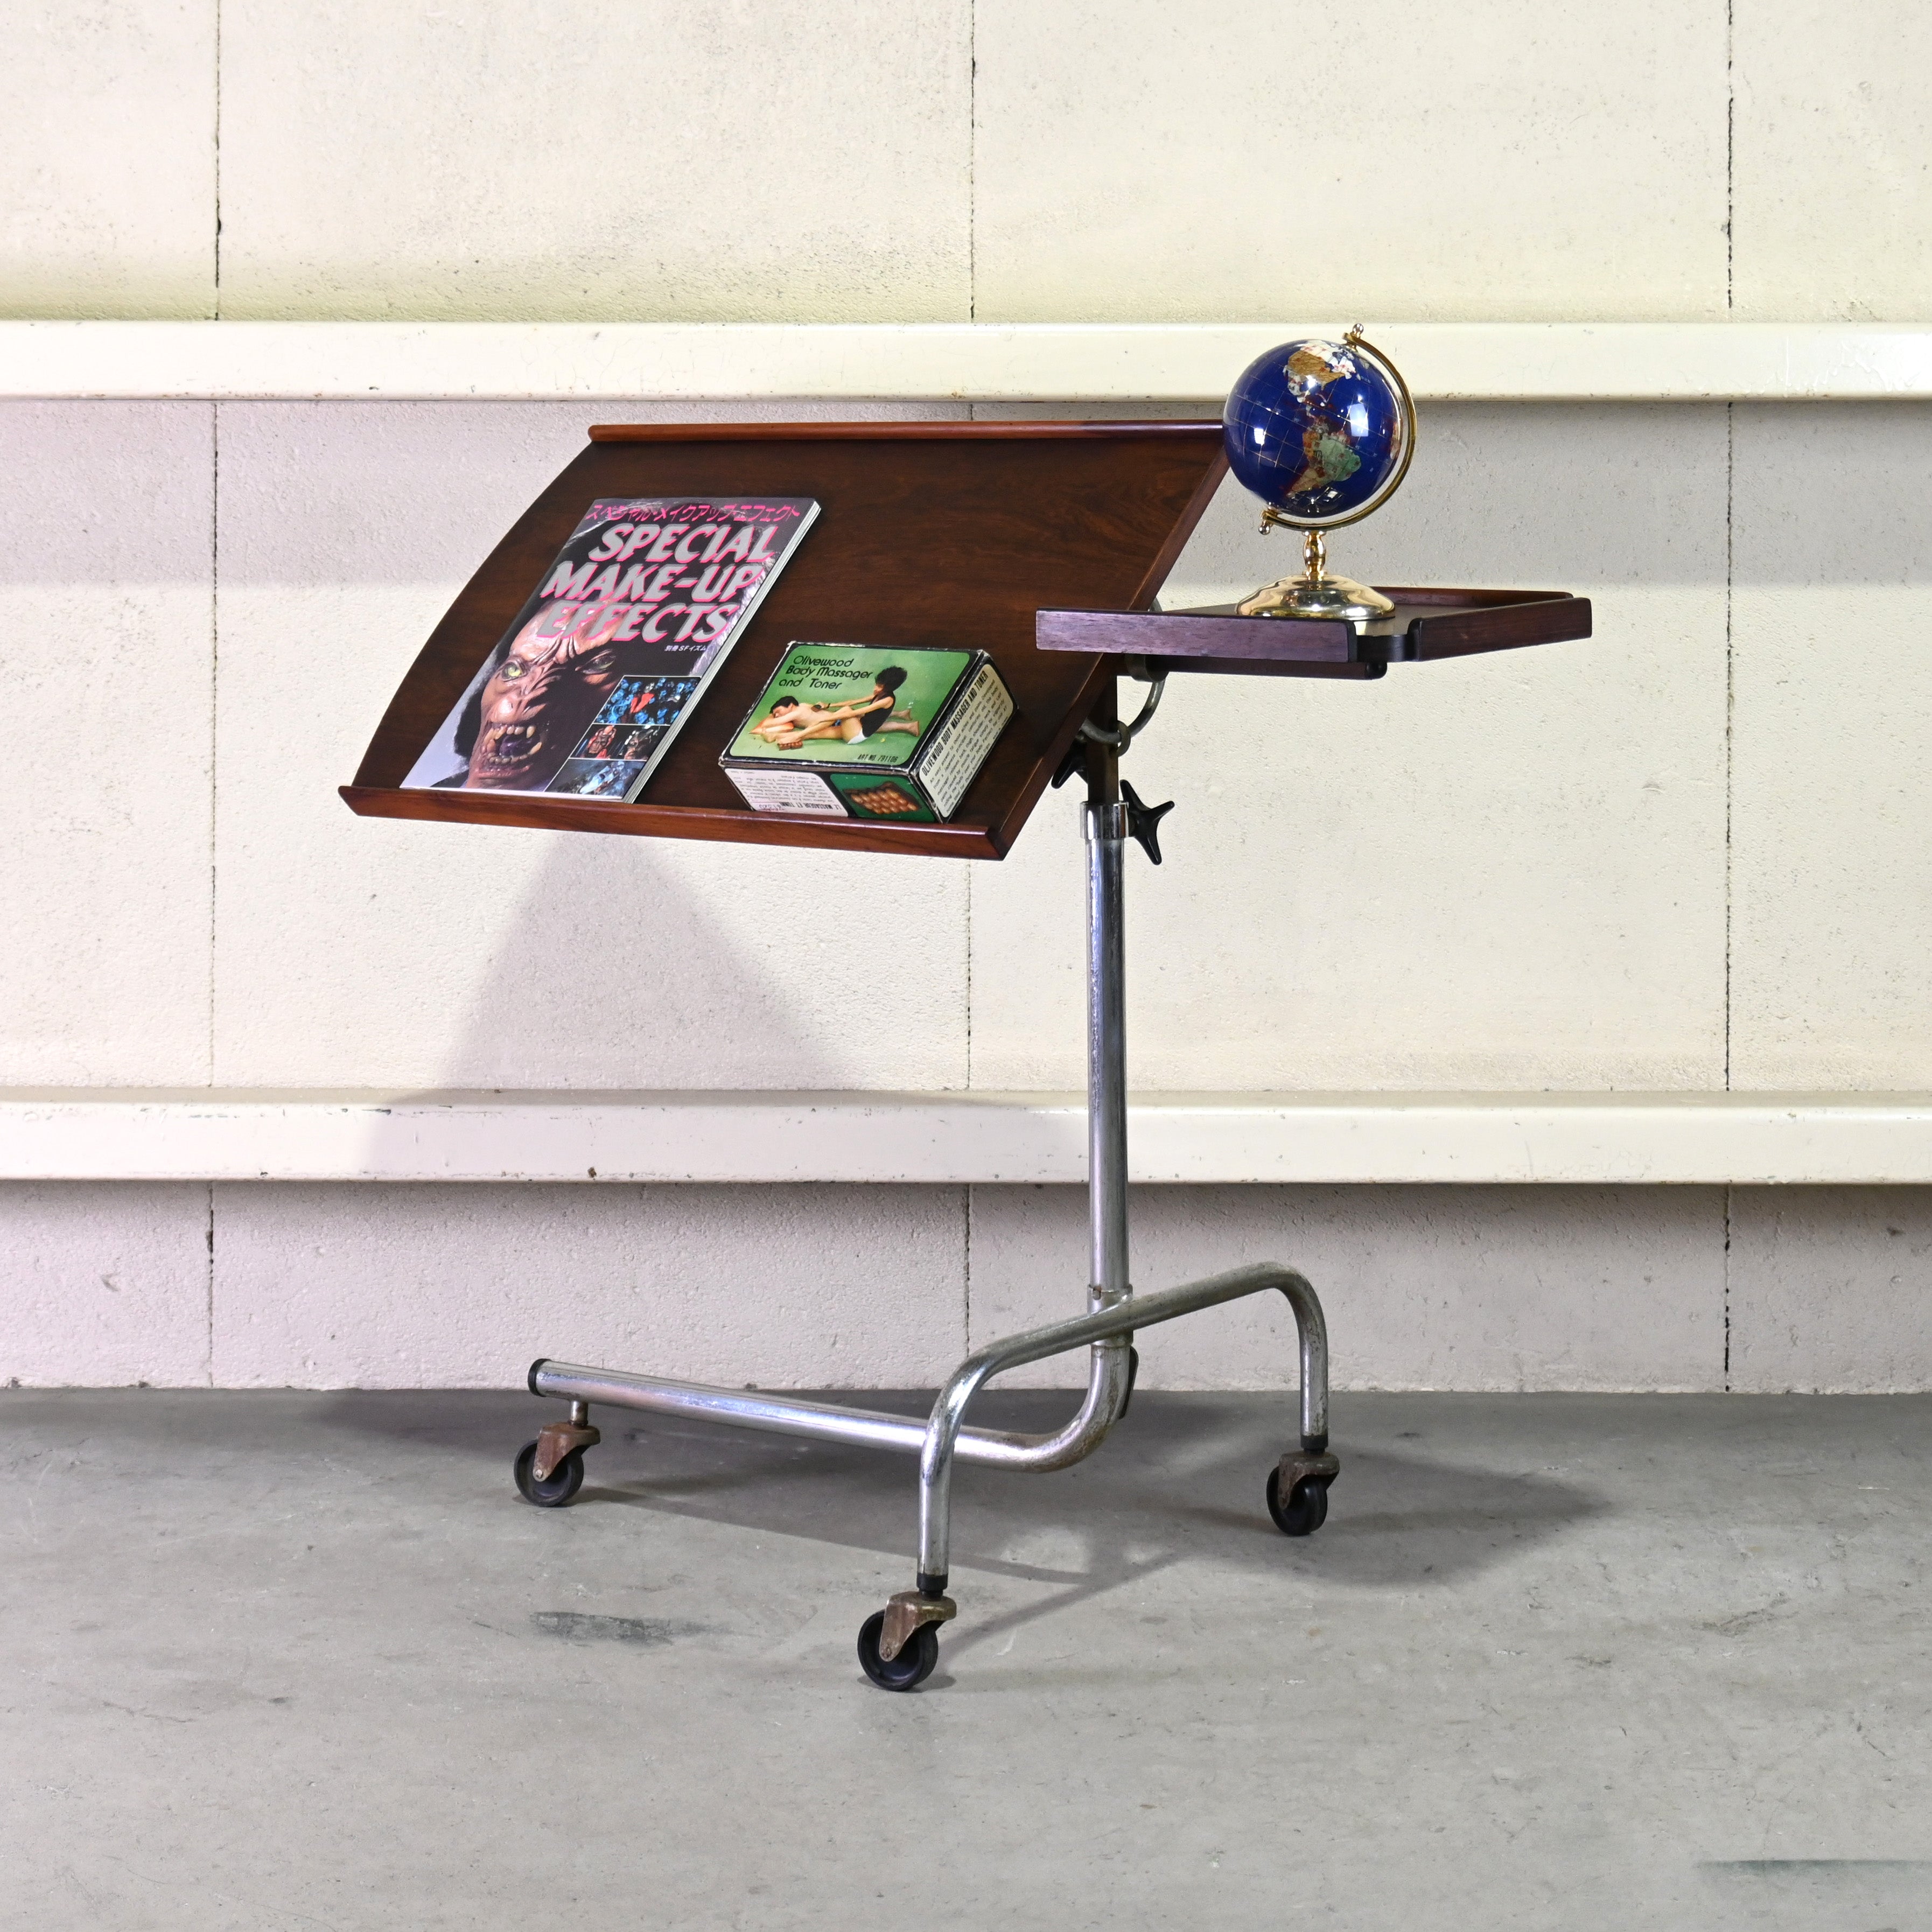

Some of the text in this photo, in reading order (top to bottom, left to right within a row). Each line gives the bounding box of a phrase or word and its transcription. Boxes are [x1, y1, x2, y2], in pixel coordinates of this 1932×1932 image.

[589, 523, 779, 562] SPECIAL
[540, 561, 765, 602] MAKE-UP
[537, 600, 740, 642] EFFECTS
[786, 665, 873, 681] Body Massager
[793, 655, 855, 667] Olivewood
[779, 678, 842, 689] and Toner
[921, 670, 989, 776] OLIVEWOOD BODY MASSAGER AND TONER
